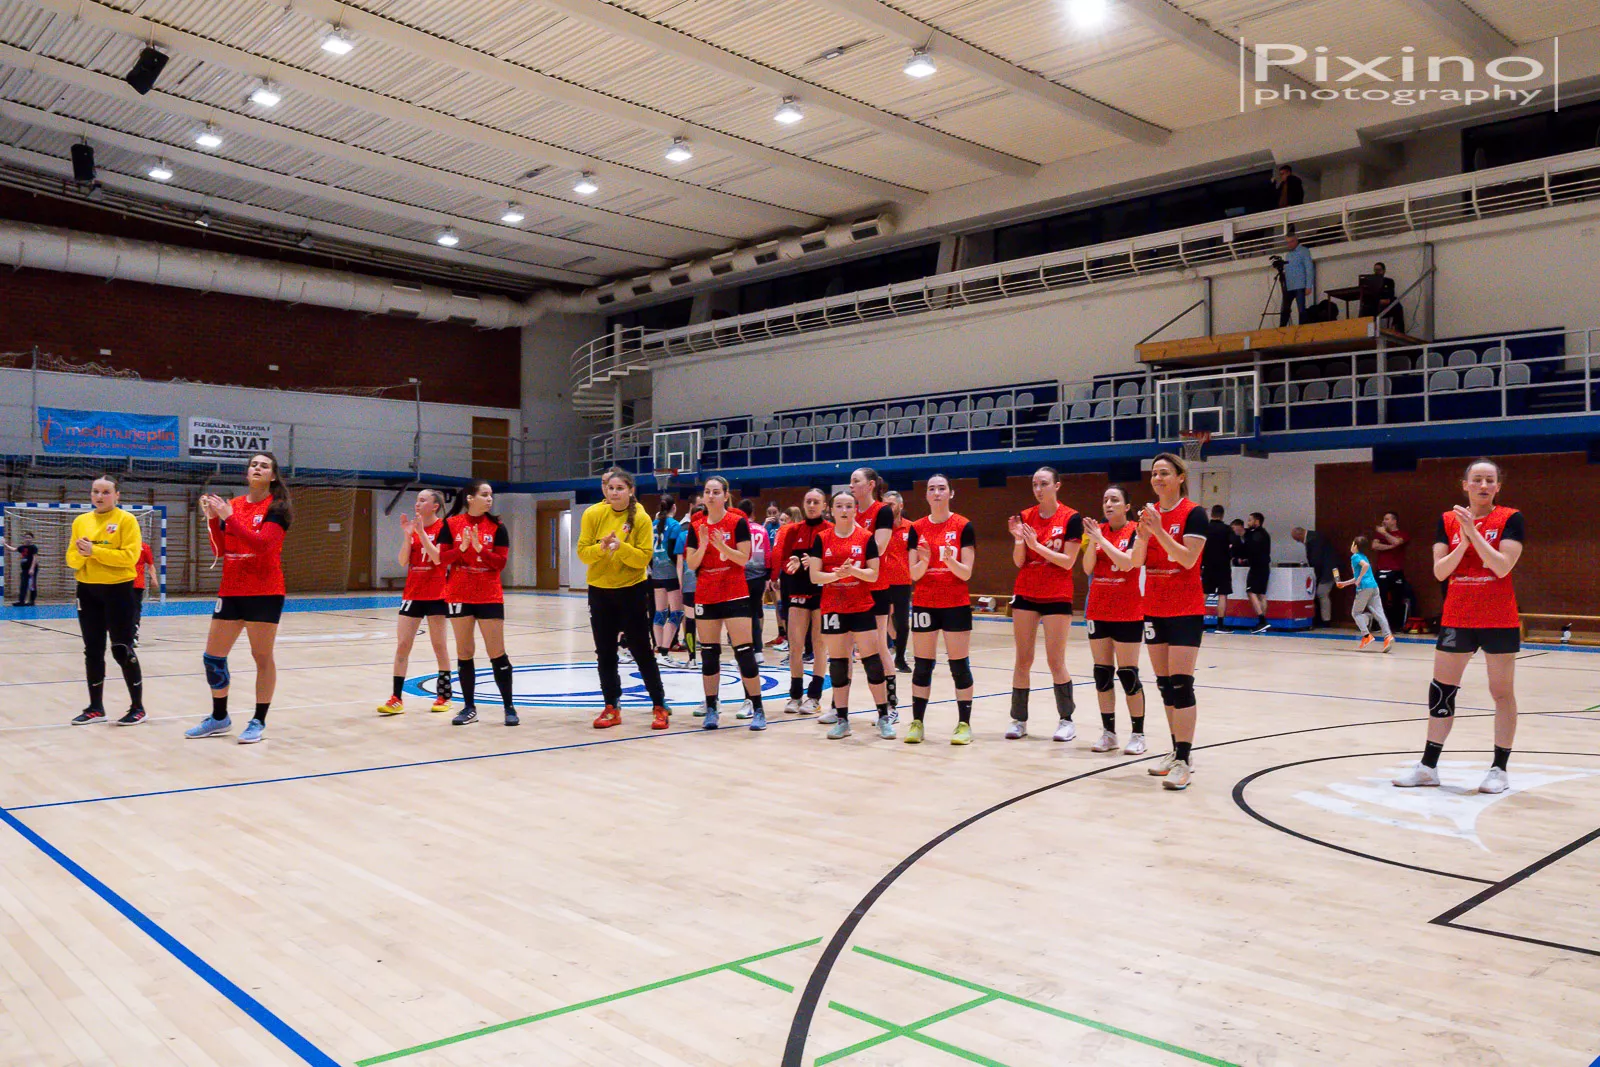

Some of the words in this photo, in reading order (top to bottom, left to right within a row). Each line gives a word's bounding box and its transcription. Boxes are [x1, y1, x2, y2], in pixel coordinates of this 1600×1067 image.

[193, 433, 269, 450] HORVAT
[751, 533, 764, 553] 12
[823, 613, 840, 630] 14
[913, 612, 932, 628] 10
[1441, 627, 1457, 648] 2
